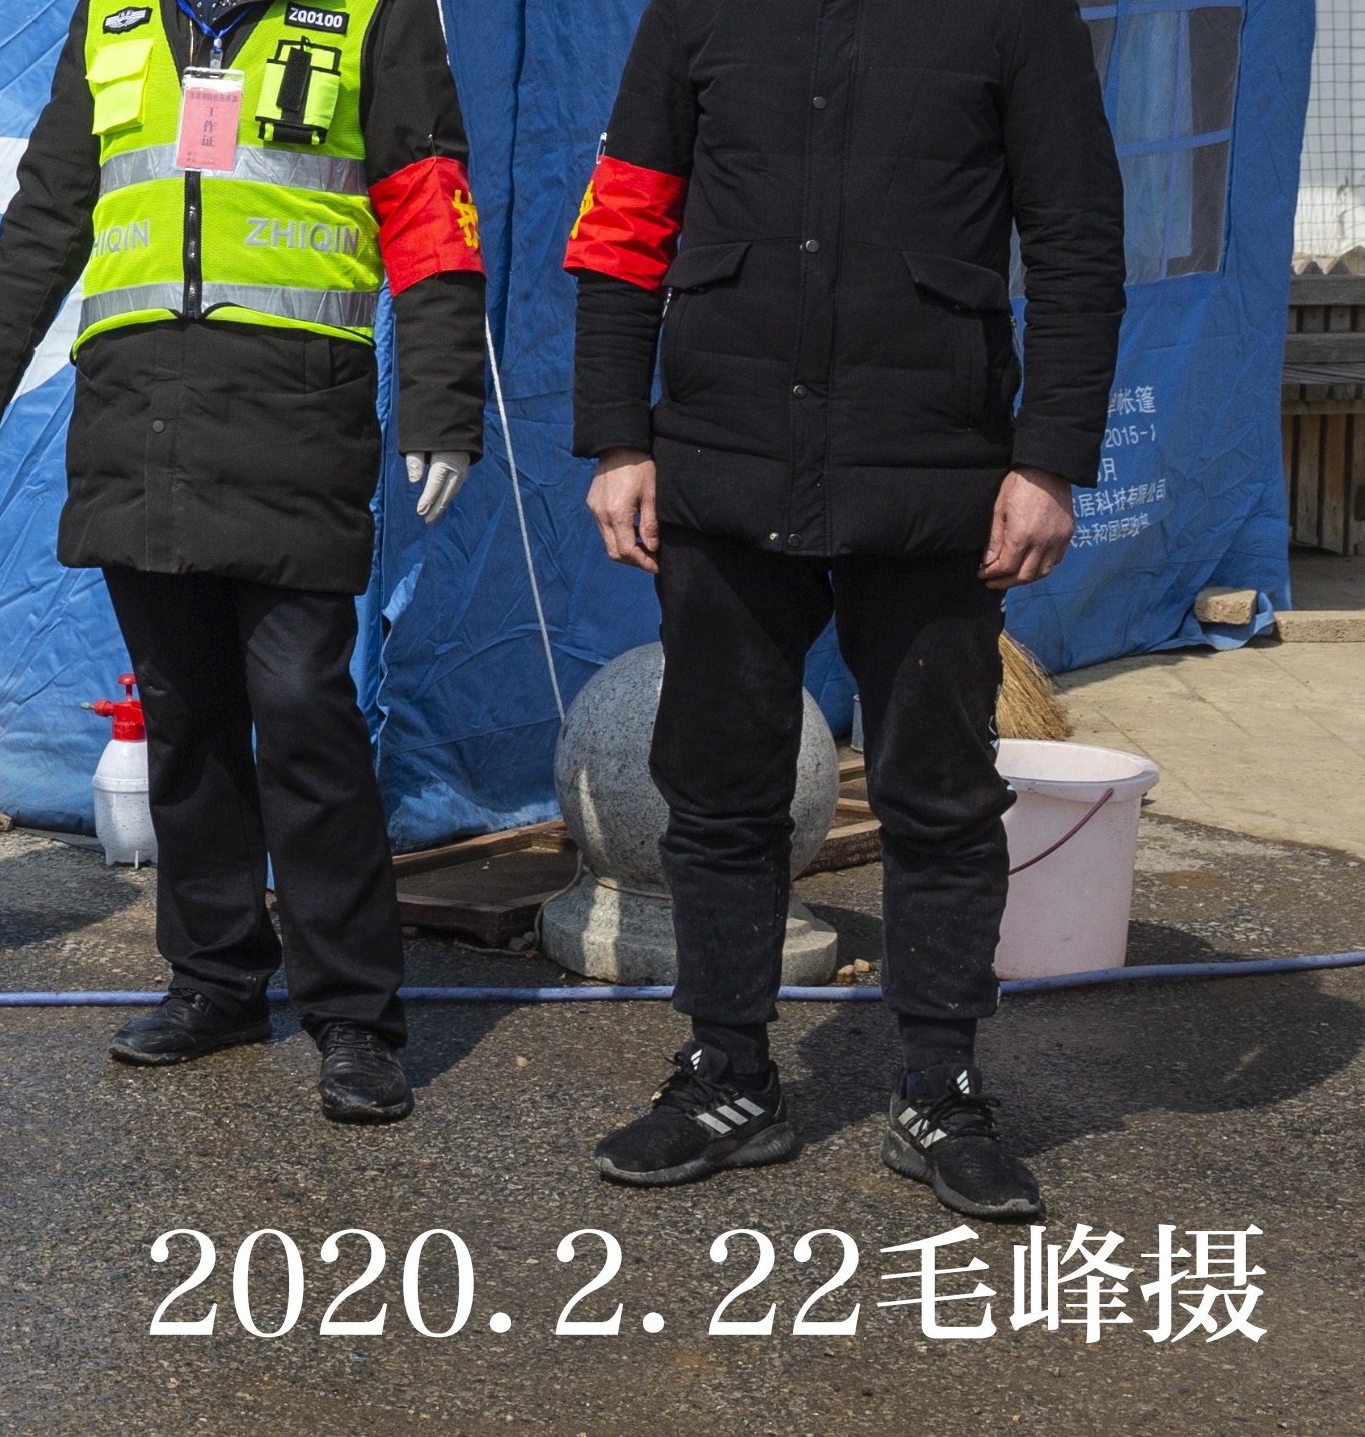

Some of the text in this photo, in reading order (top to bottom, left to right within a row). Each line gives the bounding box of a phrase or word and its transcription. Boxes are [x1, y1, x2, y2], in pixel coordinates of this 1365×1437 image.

[287, 7, 343, 28] ZQ0100
[91, 219, 150, 257] HIQIN
[244, 217, 359, 255] ZHIQIN
[1097, 457, 1117, 482] 月
